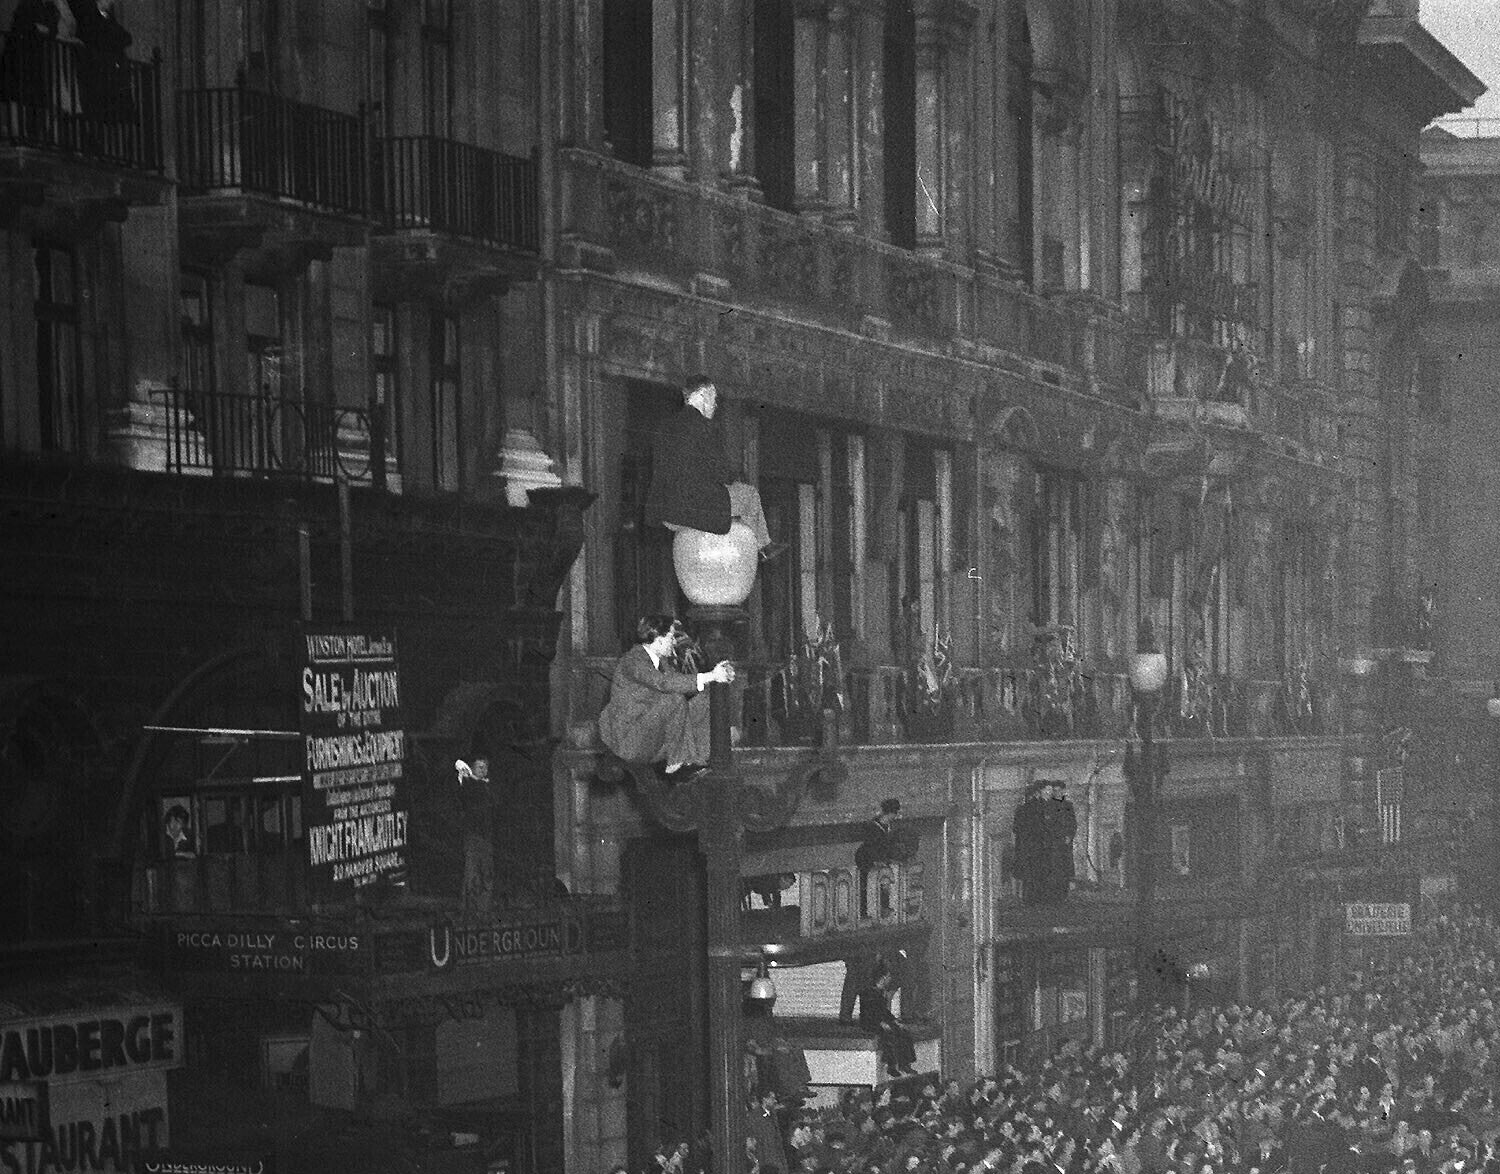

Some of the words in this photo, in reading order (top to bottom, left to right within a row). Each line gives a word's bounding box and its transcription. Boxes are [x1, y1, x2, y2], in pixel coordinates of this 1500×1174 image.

[303, 667, 340, 712] SALE
[352, 668, 399, 711] AUCTION
[177, 932, 275, 949] PICCADILLY
[294, 935, 359, 950] CIRCUS
[230, 954, 303, 969] STATION
[430, 922, 584, 967] UNDERGROUND
[0, 1014, 174, 1080] AUBERGE
